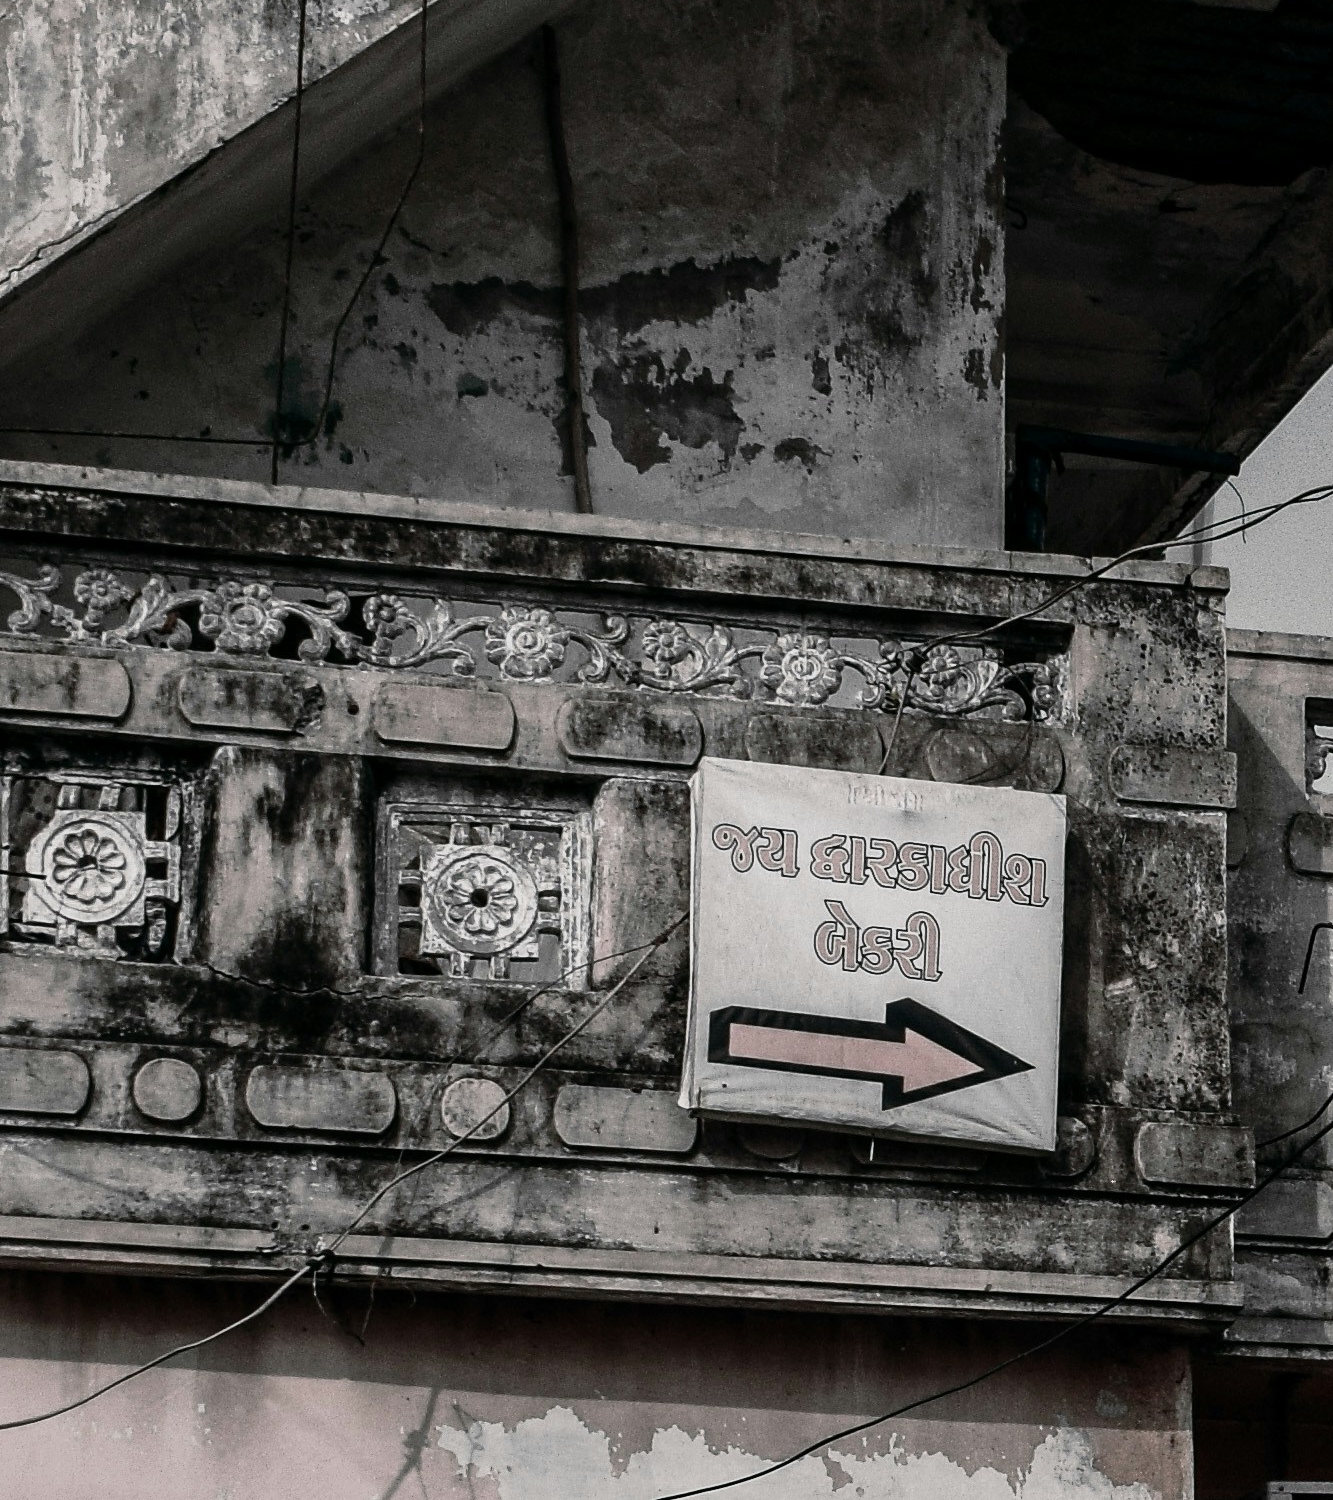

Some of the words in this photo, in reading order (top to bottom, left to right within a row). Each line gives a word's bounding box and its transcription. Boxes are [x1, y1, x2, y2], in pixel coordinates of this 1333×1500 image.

[712, 824, 800, 878] જય
[810, 831, 1050, 907] દ્વારકાધીશ
[814, 900, 942, 982] બેકરી
